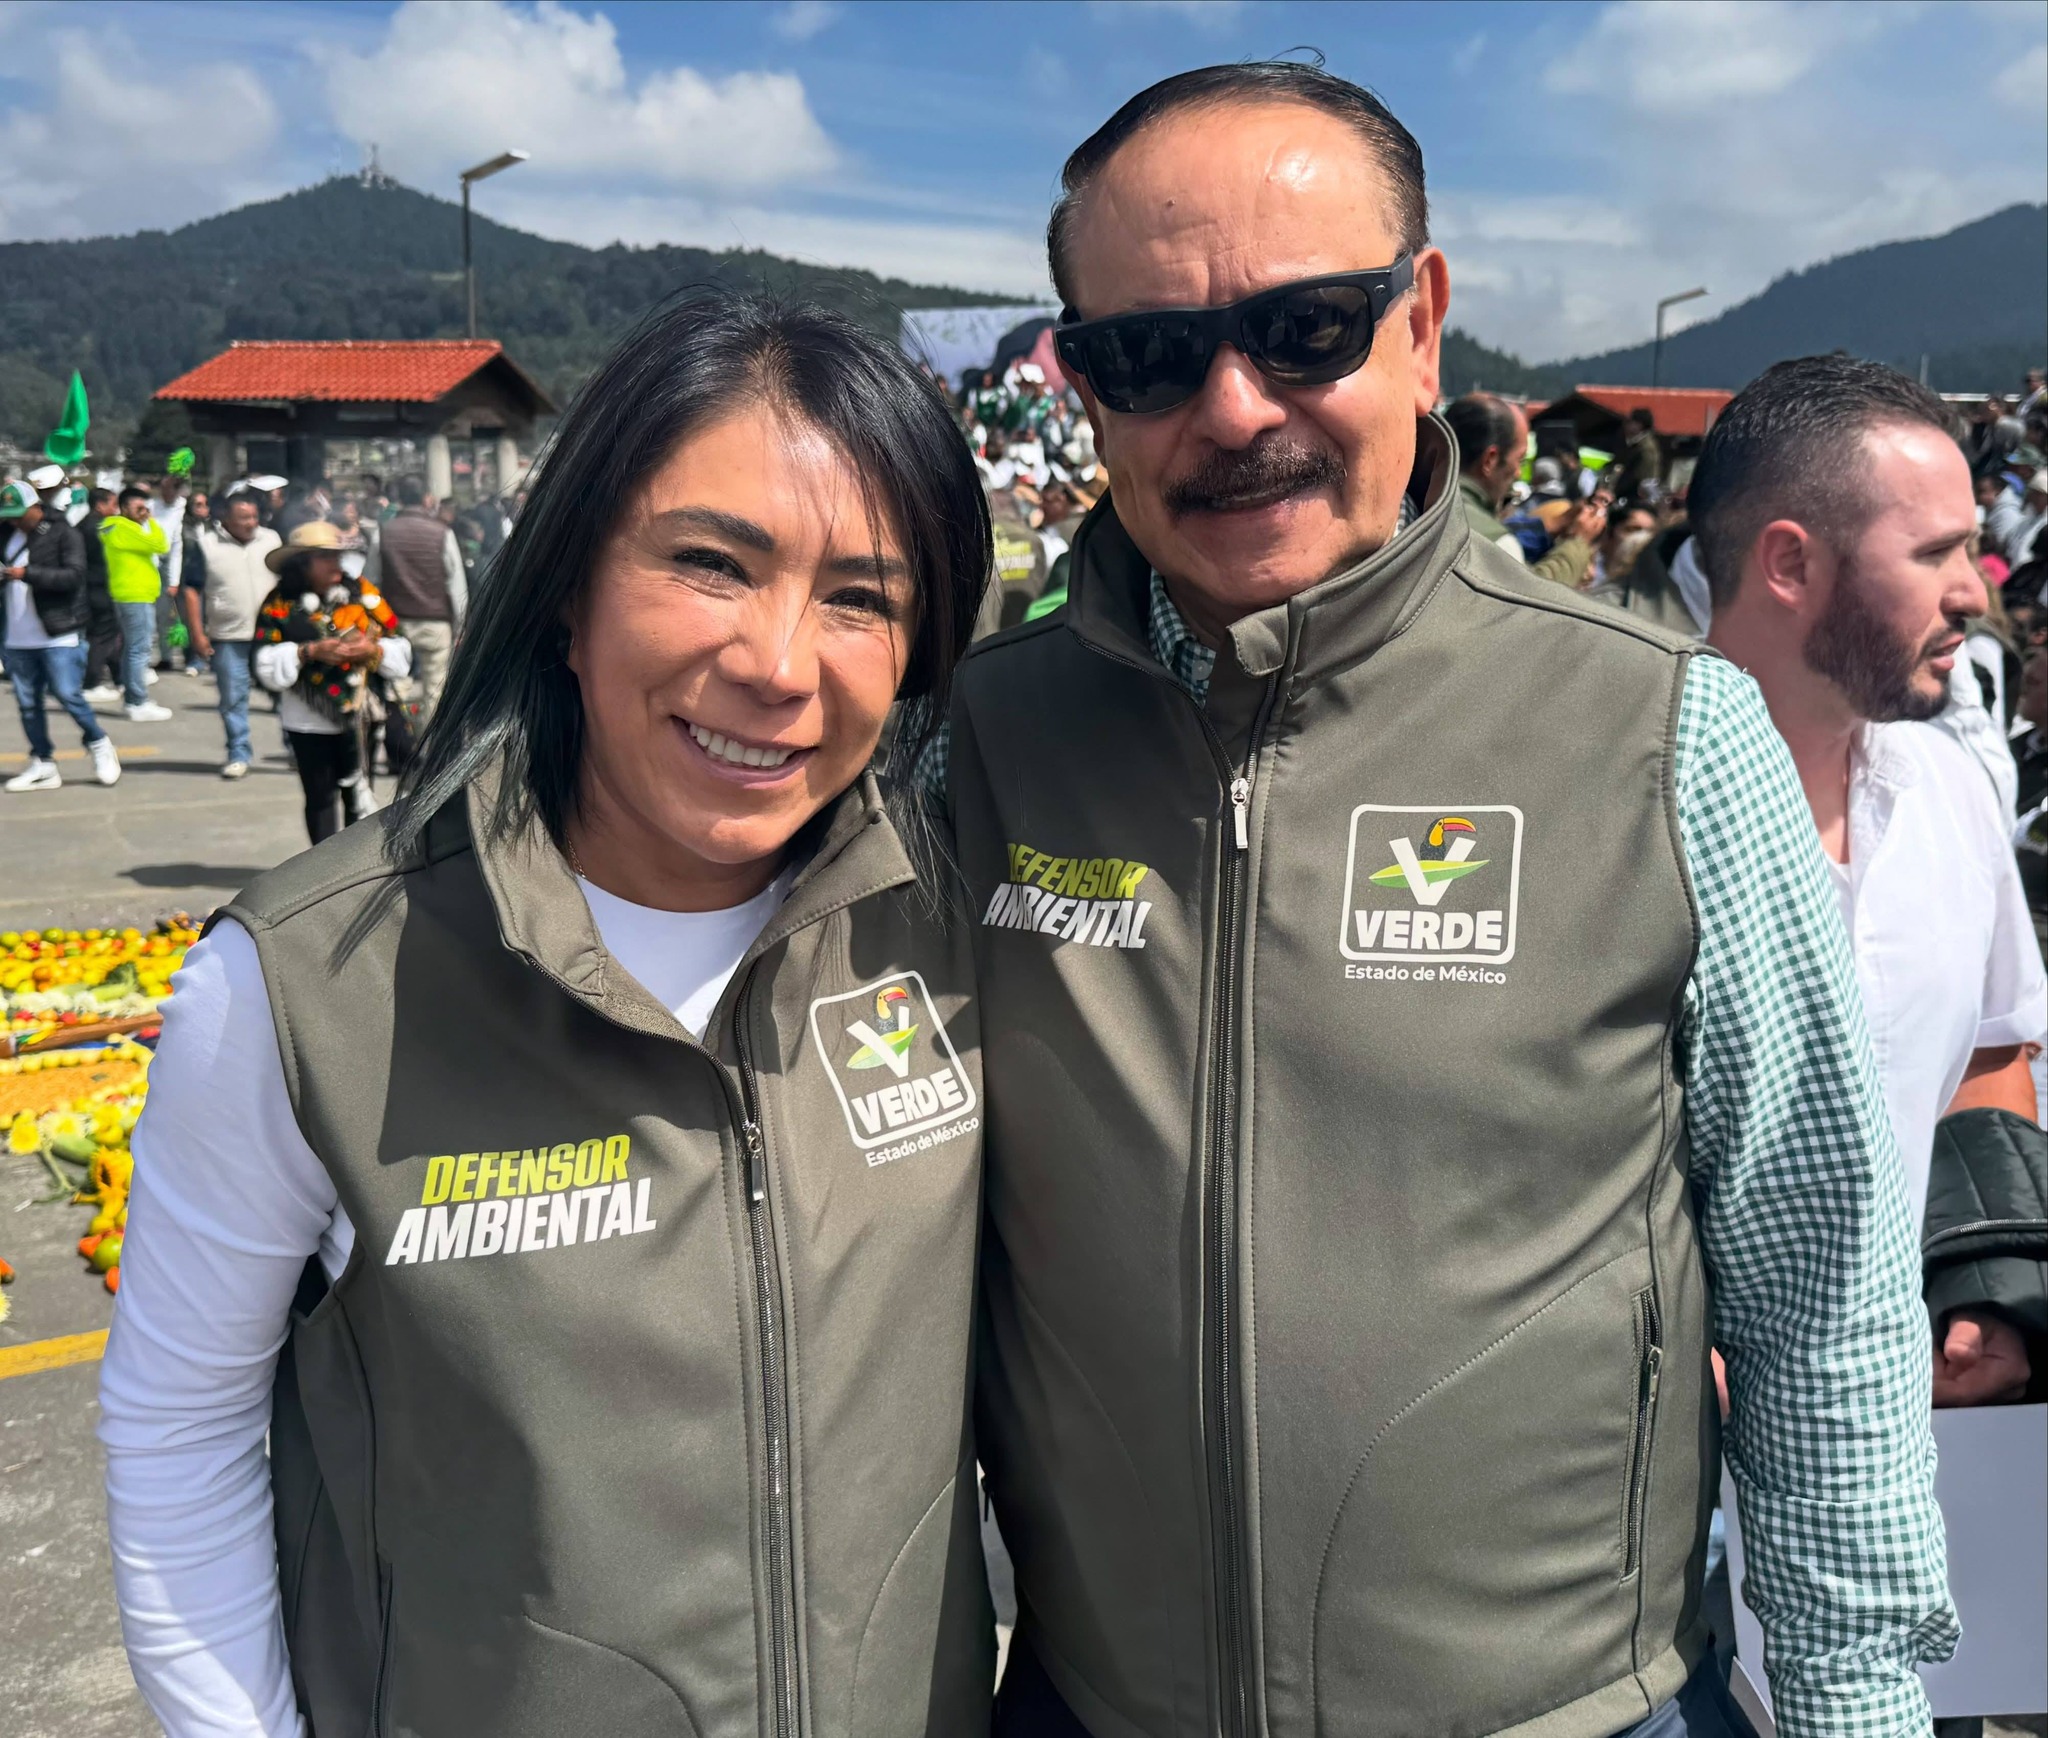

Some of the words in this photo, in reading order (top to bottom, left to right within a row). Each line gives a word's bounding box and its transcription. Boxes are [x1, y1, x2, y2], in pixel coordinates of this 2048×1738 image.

[982, 883, 1153, 949] AMBIENTAL
[1354, 910, 1503, 951] VERDE
[1344, 964, 1410, 981] Estado
[1412, 966, 1436, 981] de
[1439, 965, 1507, 985] México
[851, 1067, 965, 1135] VERDE
[421, 1134, 631, 1205] DEFENSOR
[865, 1140, 918, 1168] Estado
[917, 1135, 933, 1150] de
[930, 1117, 980, 1146] México
[384, 1177, 657, 1266] AMBIENTAL
